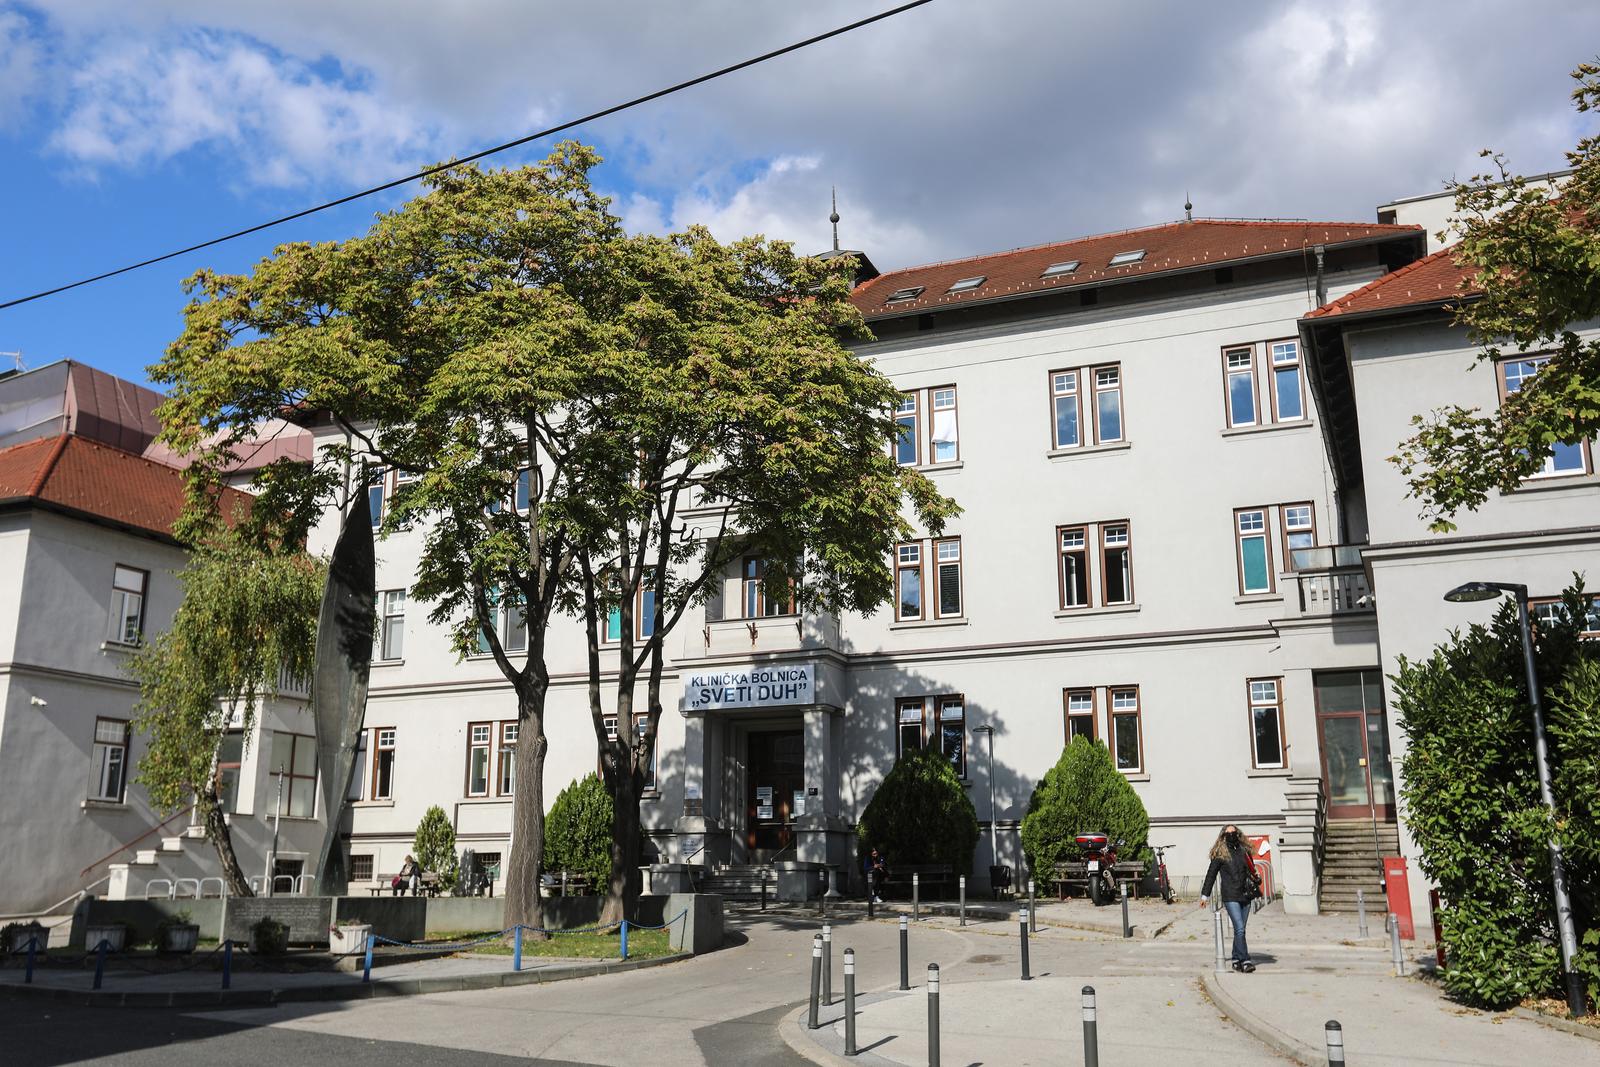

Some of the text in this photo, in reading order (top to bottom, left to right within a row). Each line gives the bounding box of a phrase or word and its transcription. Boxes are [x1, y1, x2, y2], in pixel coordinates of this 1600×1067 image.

[692, 670, 808, 687] KLINIČKA BOLNICA
[692, 686, 752, 707] „SVETI
